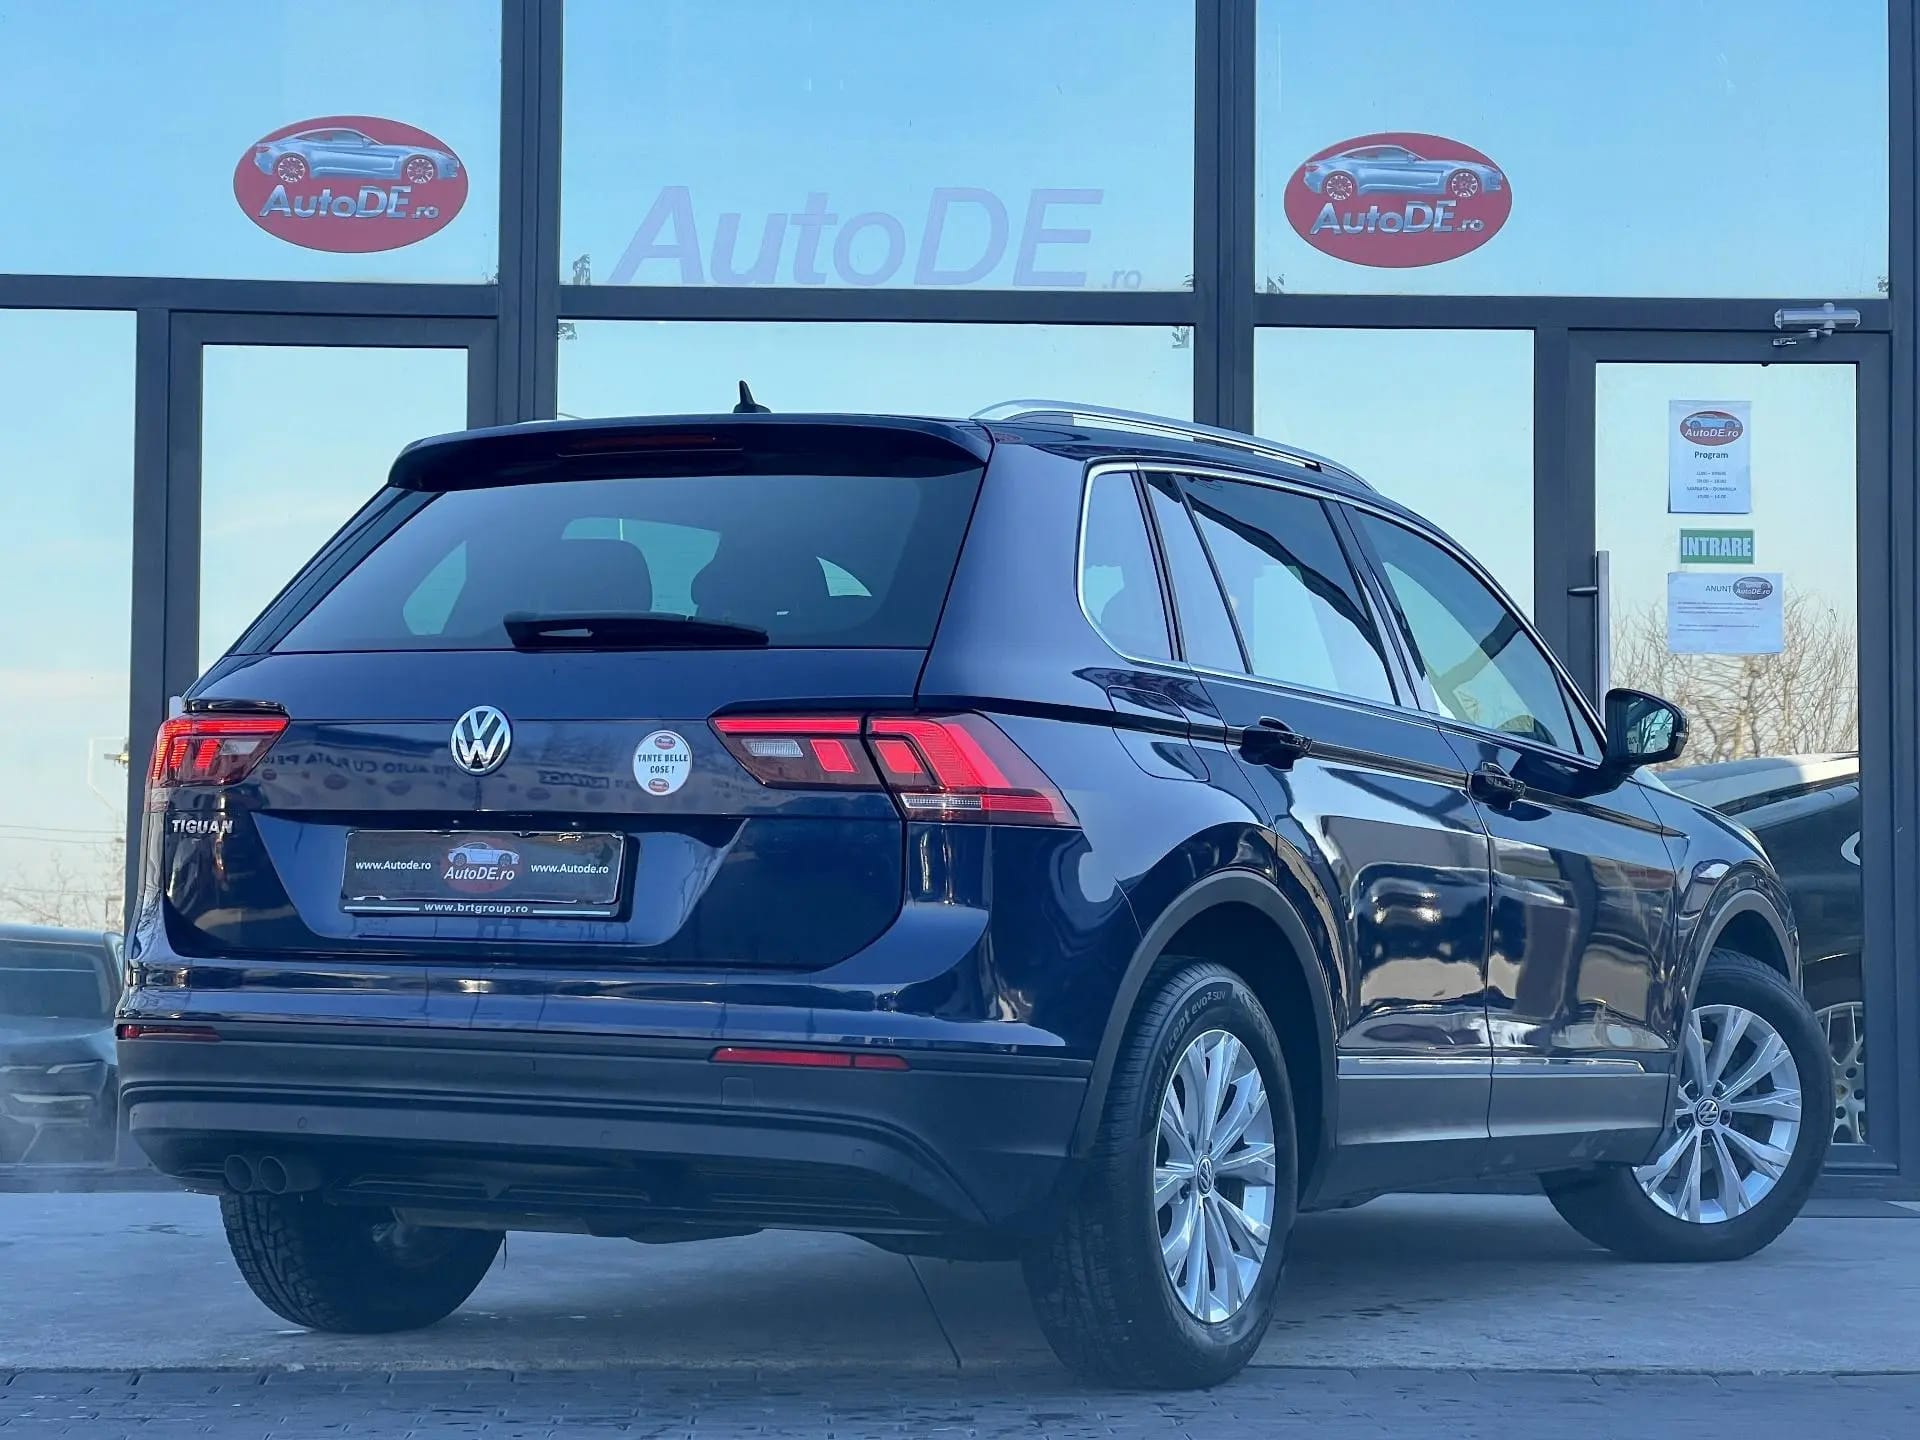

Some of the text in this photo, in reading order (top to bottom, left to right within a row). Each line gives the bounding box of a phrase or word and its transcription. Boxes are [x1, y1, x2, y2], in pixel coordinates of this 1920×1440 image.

[1685, 428, 1739, 438] AutoDE.ro
[1694, 451, 1729, 460] Program
[1682, 536, 1752, 557] INTRARE
[637, 754, 662, 762] TANTE
[650, 765, 670, 774] COSE
[171, 819, 233, 834] TIGUAN
[355, 860, 432, 871] www.Autode.ro
[530, 863, 609, 874] www.Autode.ro
[443, 866, 515, 881] AutoDE.ro
[424, 902, 529, 915] www.brtgroup.ro
[1212, 991, 1226, 1001] SUV
